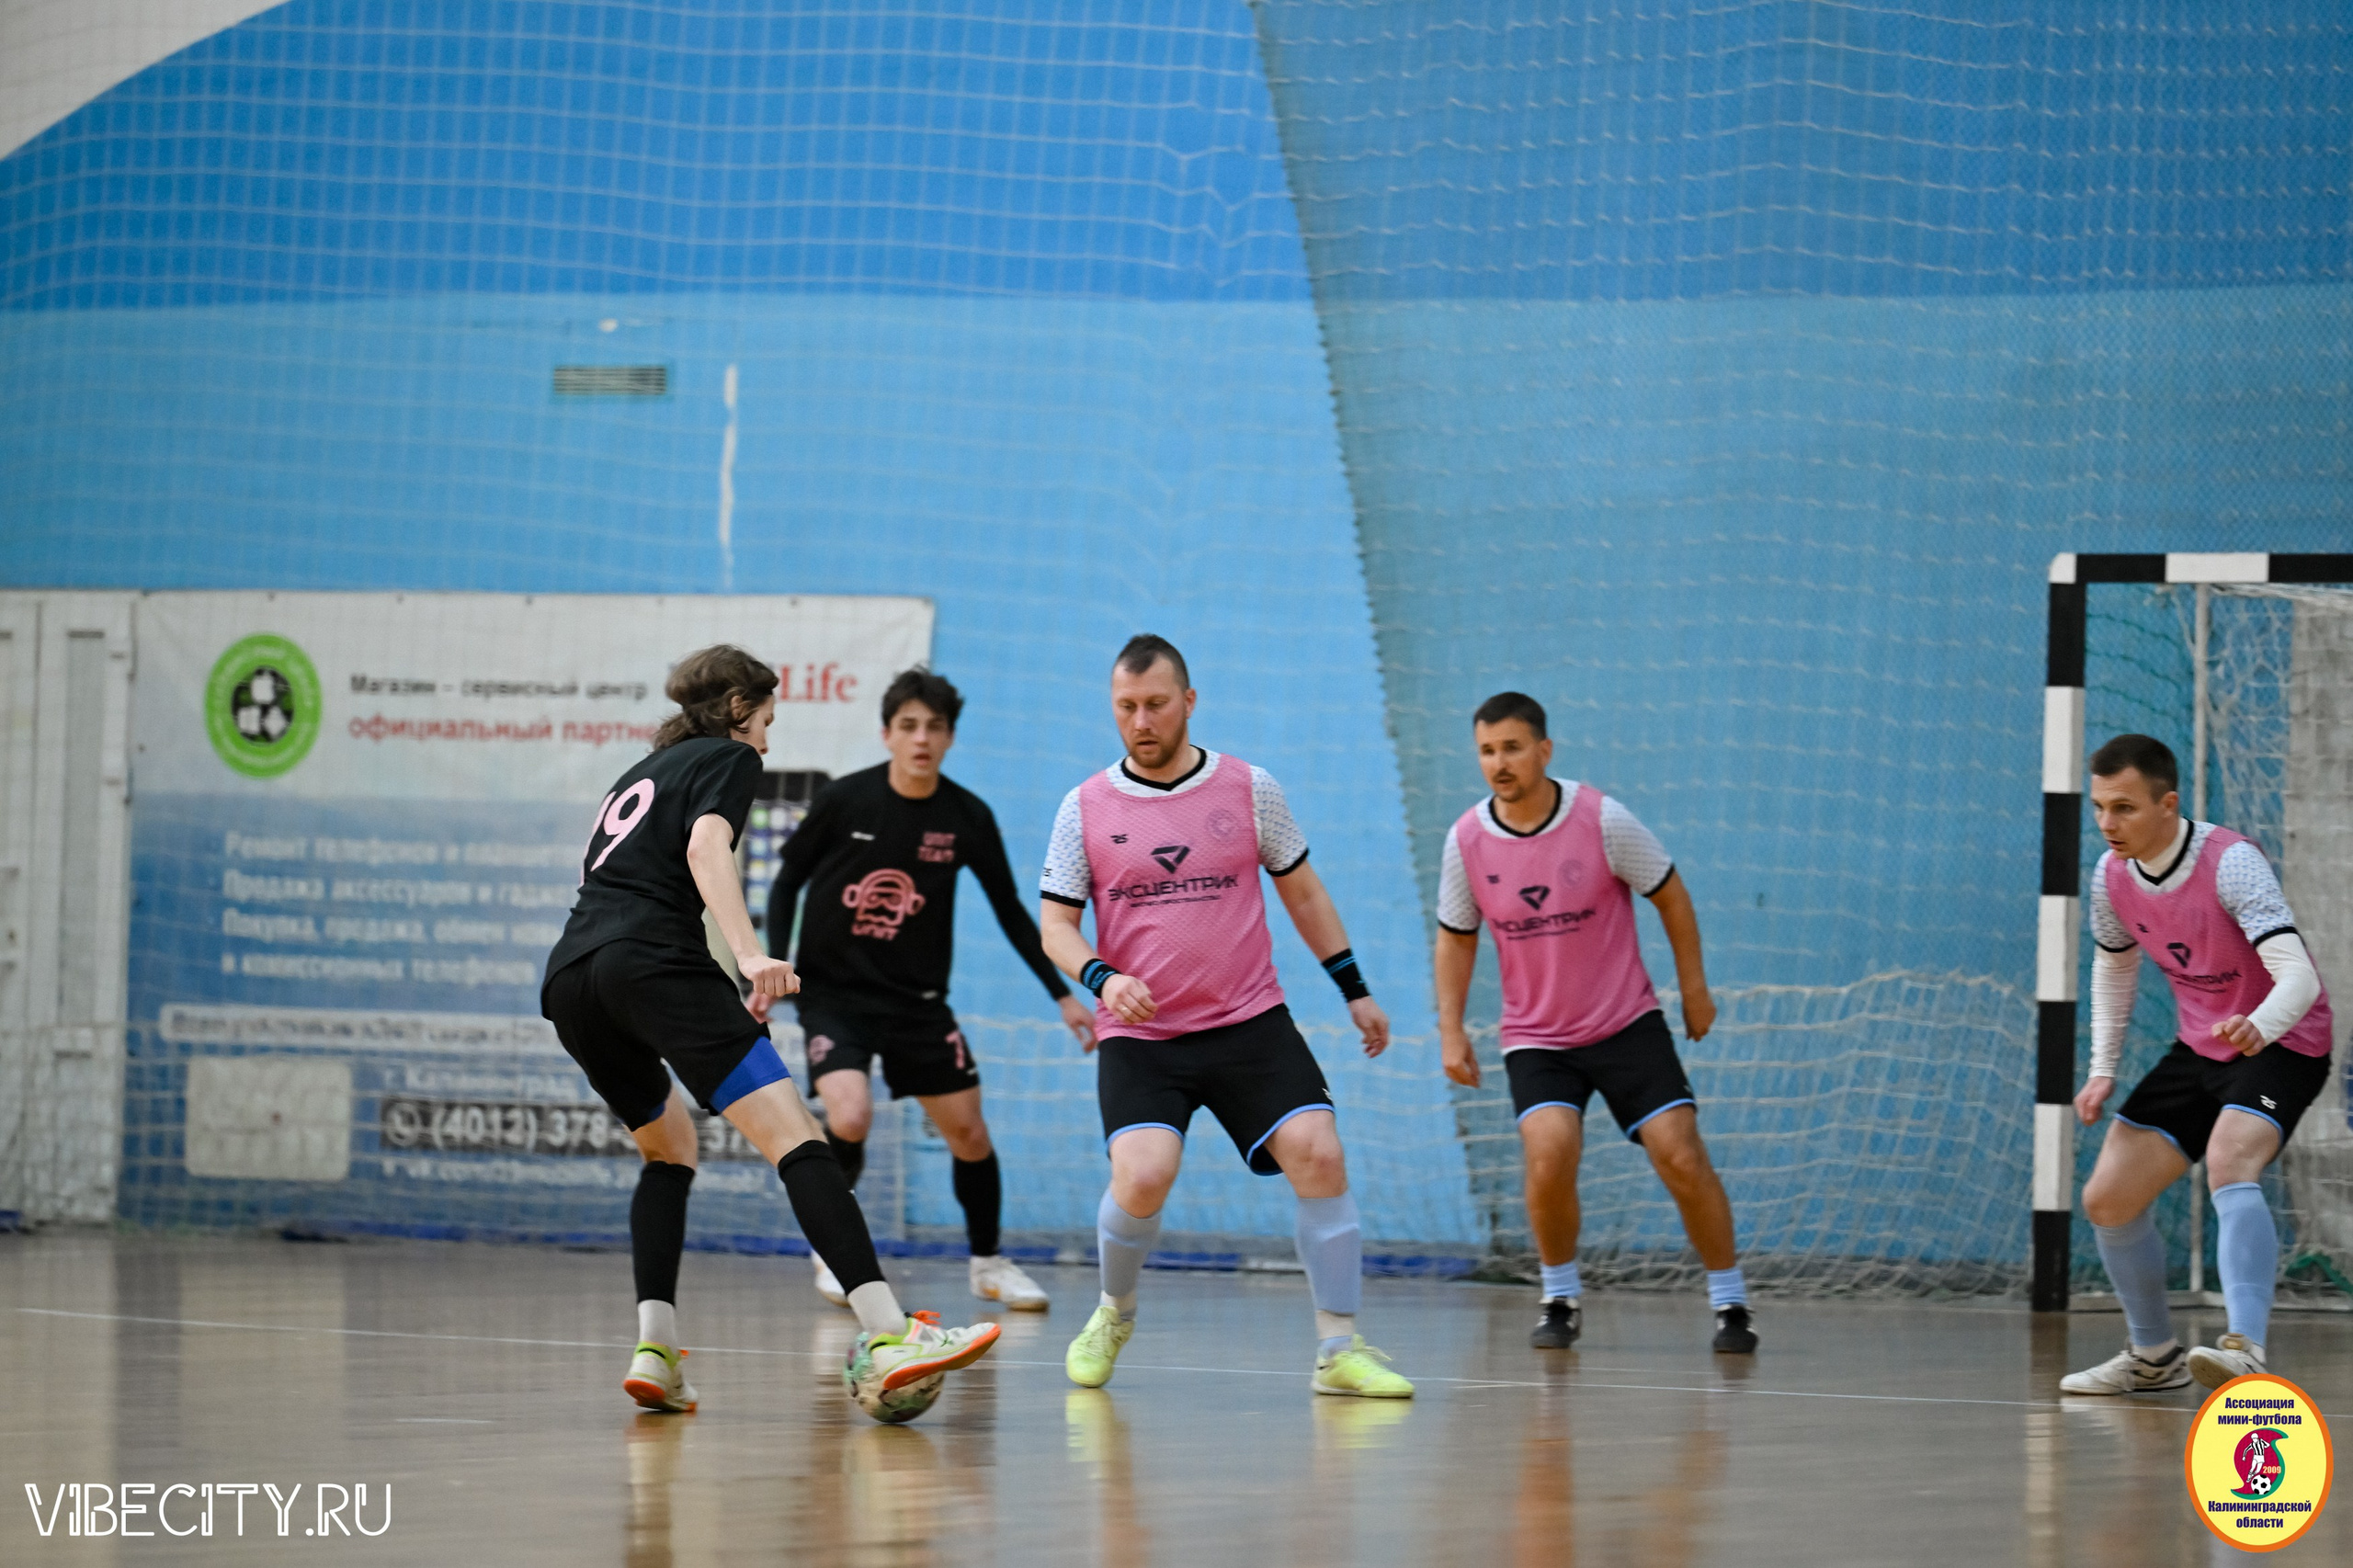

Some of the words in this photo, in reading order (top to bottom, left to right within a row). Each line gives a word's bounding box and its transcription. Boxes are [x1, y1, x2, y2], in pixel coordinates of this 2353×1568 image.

[349, 672, 437, 696] Магазин
[460, 676, 579, 702] сервисный
[585, 680, 648, 700] центр
[347, 711, 553, 743] официальный
[1108, 873, 1239, 902] ЭКСЦЕНТРИК
[432, 1106, 539, 1153] (4012)
